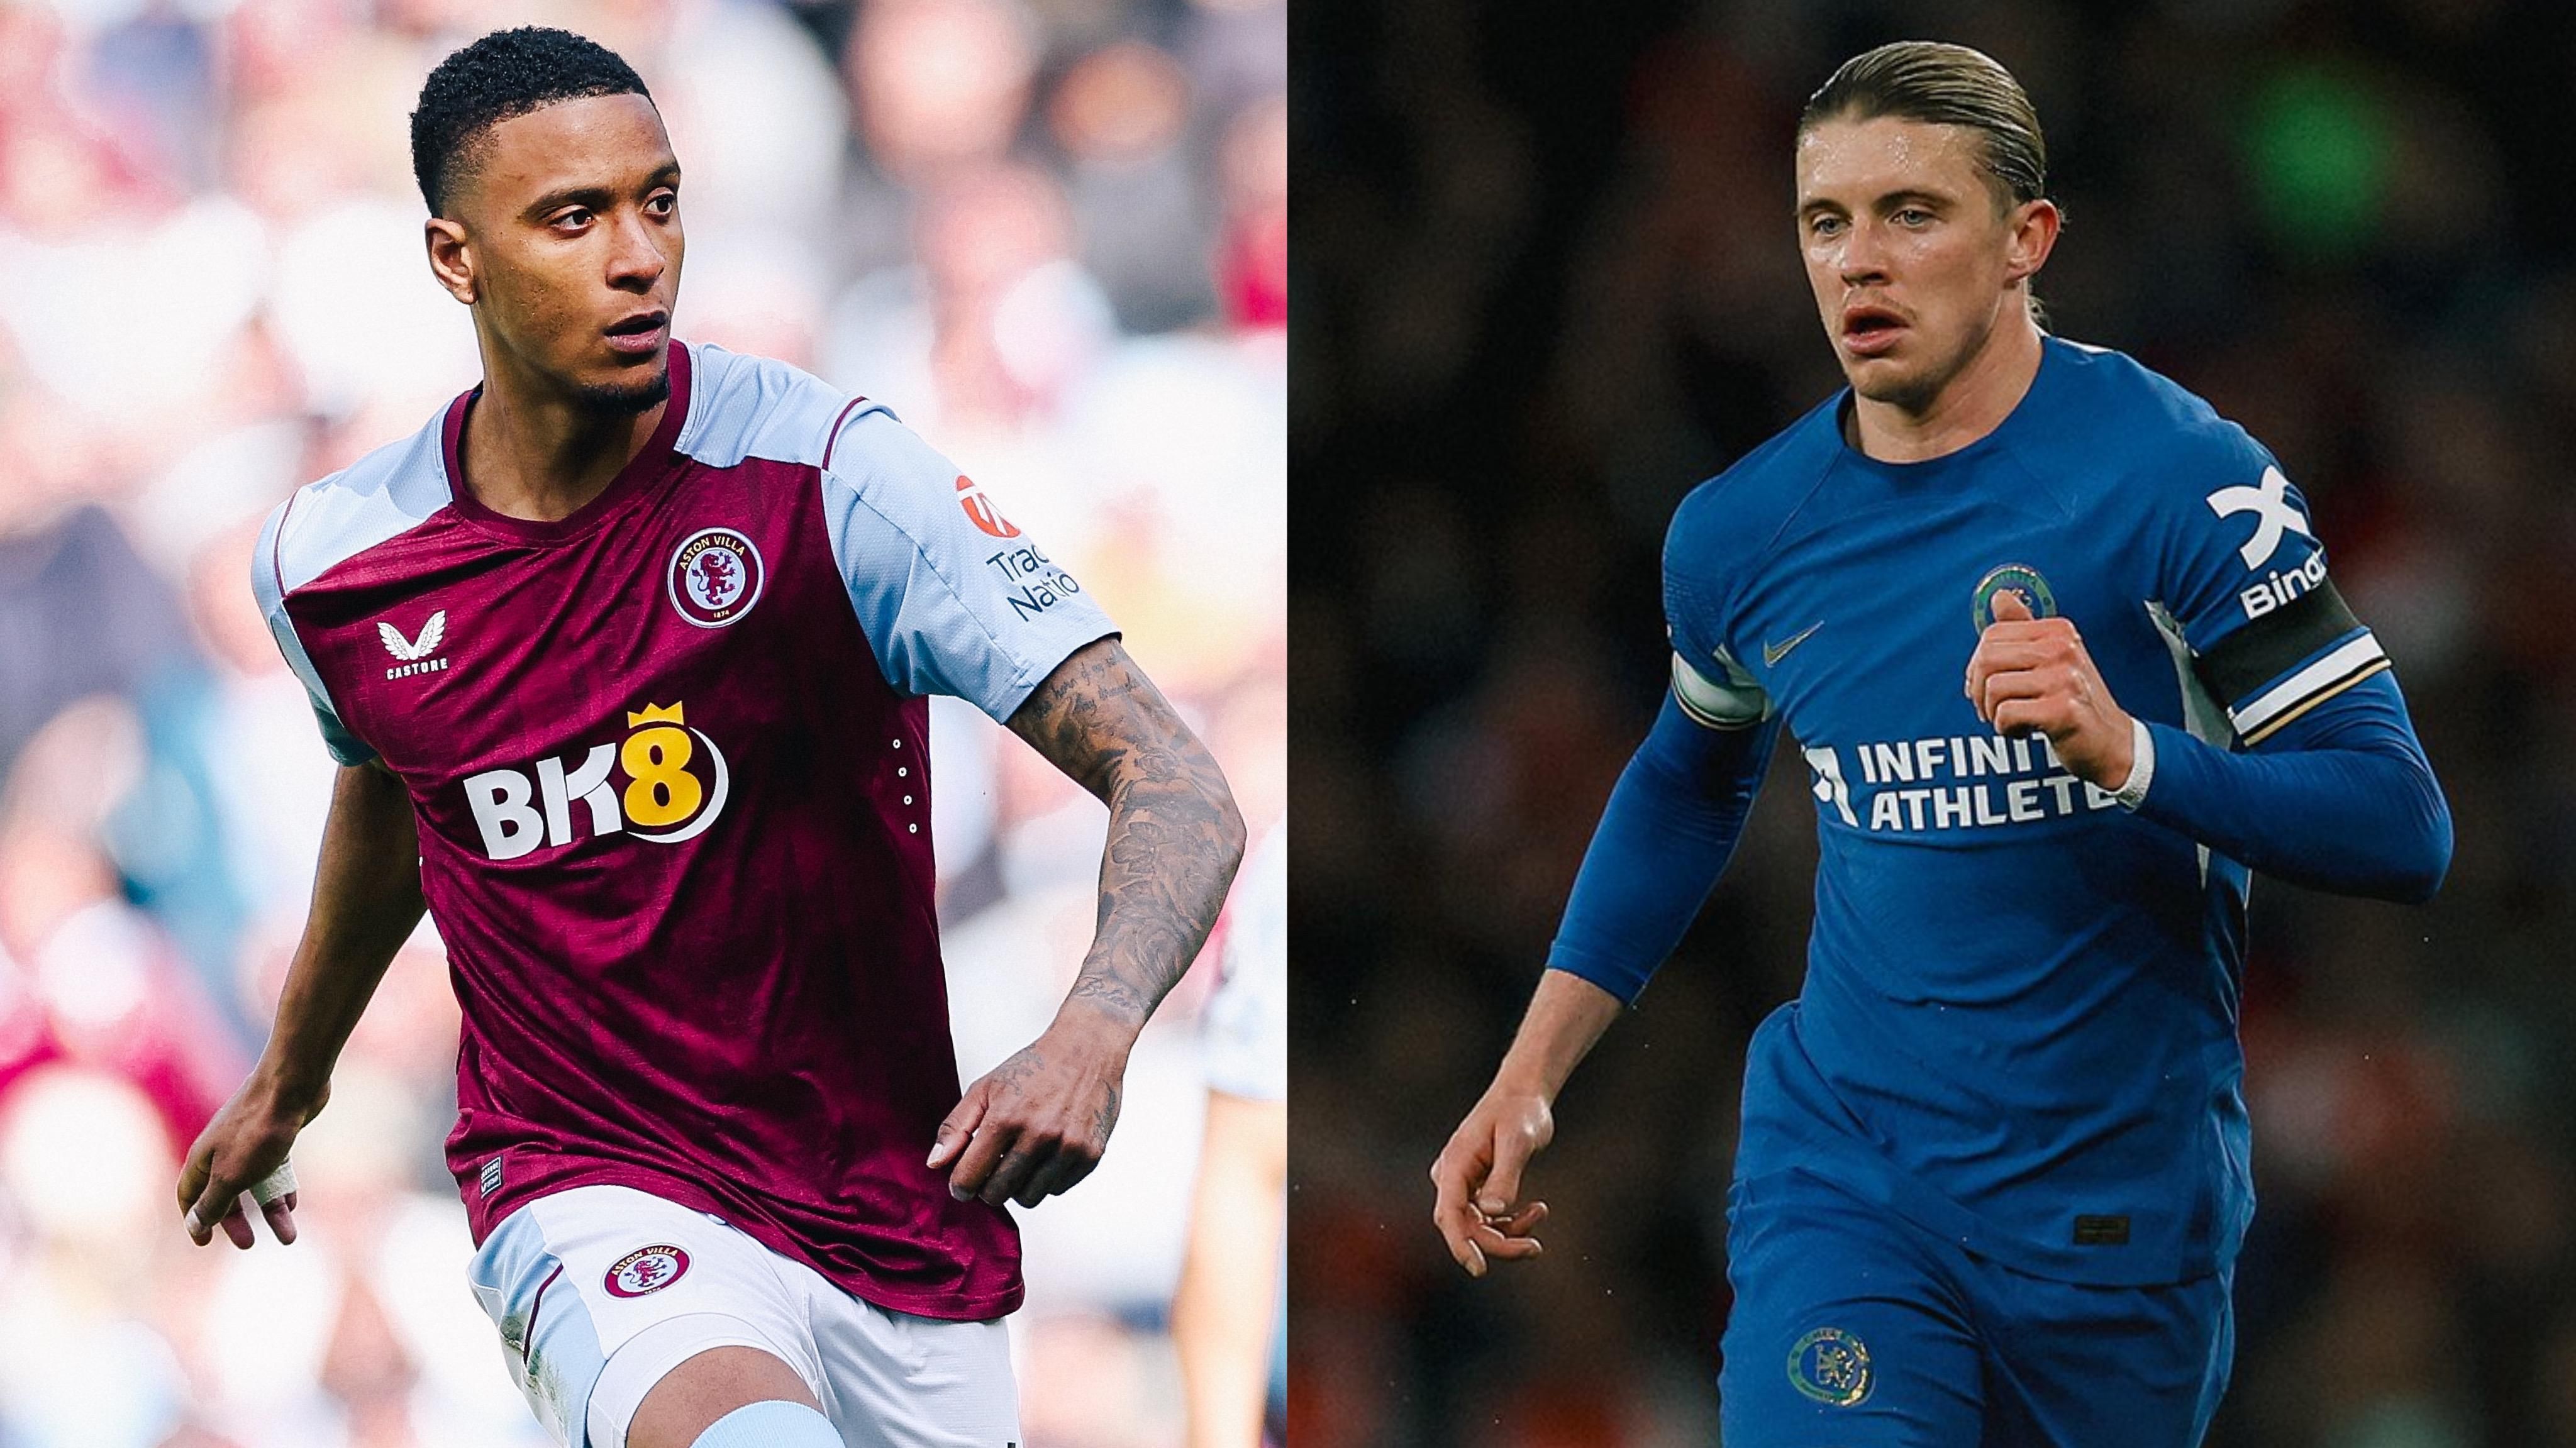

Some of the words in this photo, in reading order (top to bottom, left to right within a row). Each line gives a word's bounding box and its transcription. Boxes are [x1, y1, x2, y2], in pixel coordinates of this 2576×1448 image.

[679, 537, 710, 570] ASTON
[713, 536, 745, 556] VILLA
[1006, 571, 1080, 622] Natio
[2240, 546, 2327, 620] Bing
[386, 658, 448, 680] CASTORE
[1857, 731, 2062, 783] INFINIT
[463, 726, 702, 861] BK8
[611, 1252, 643, 1276] ASTON
[647, 1246, 679, 1257] VILLA
